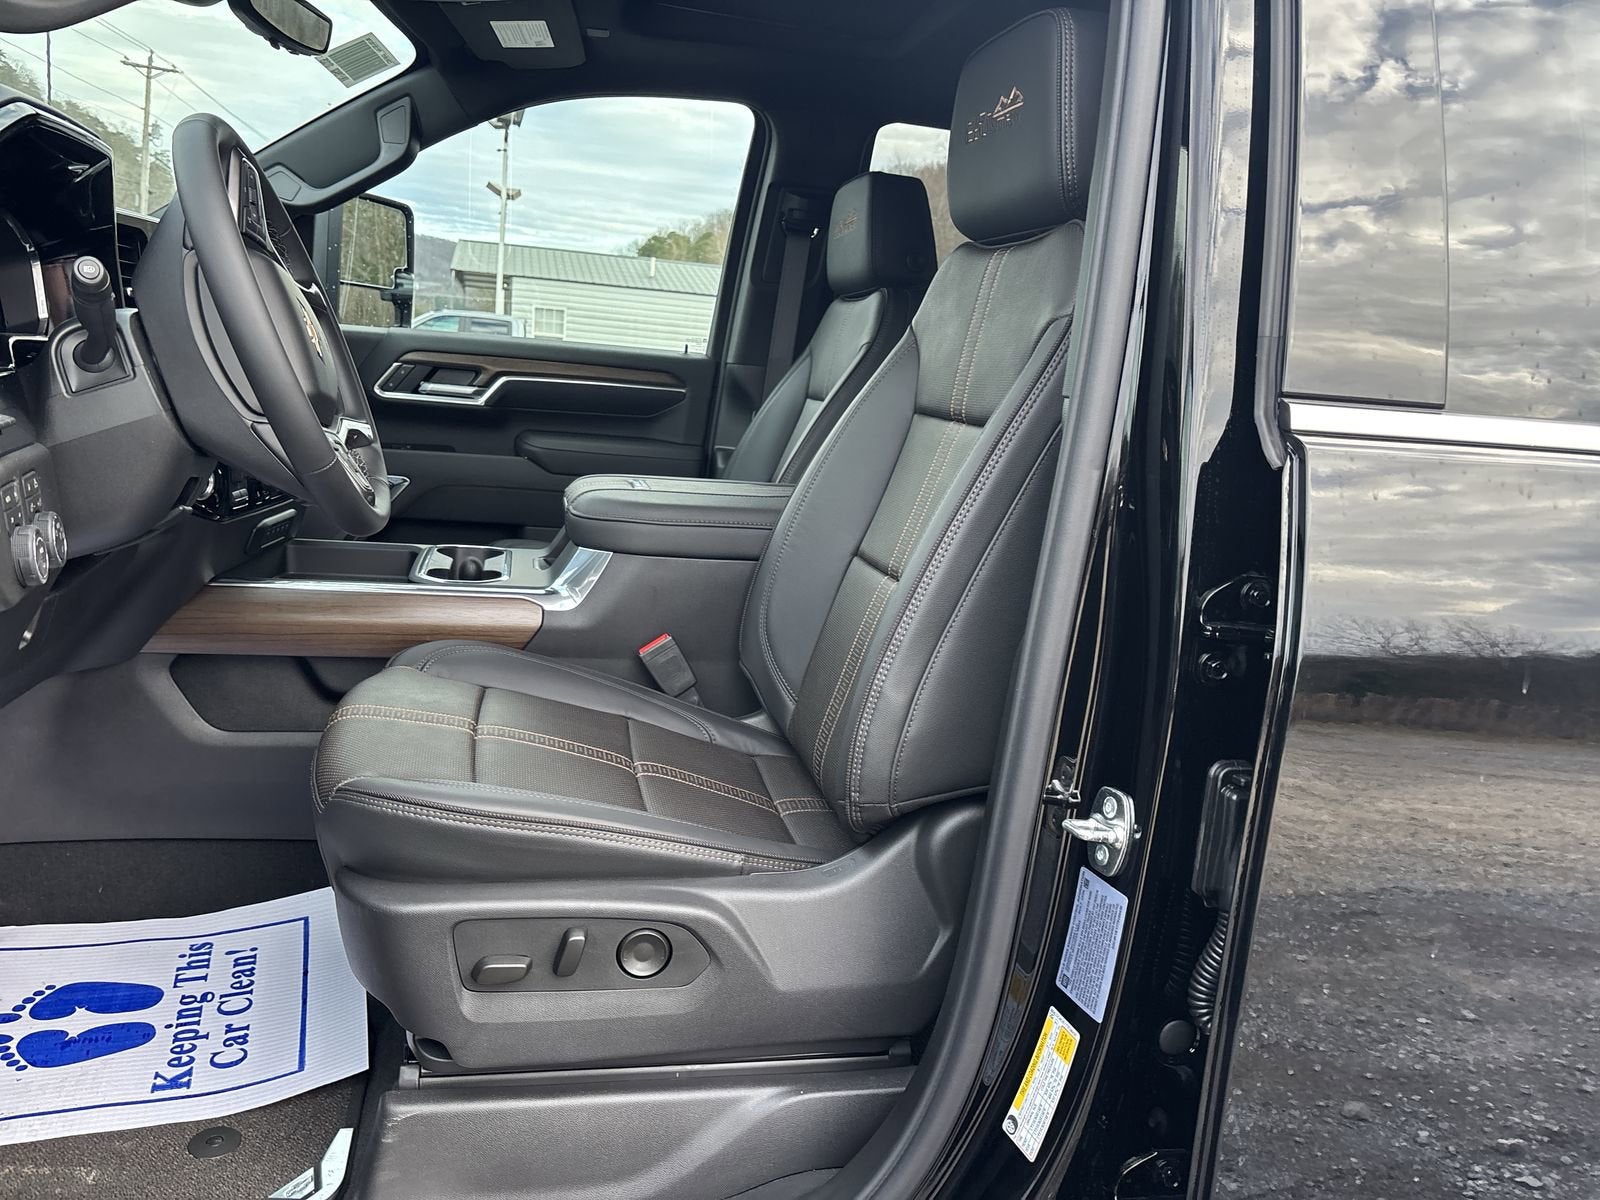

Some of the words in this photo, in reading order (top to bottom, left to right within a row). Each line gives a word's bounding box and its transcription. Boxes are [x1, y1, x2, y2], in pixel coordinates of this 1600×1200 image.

[173, 942, 214, 988] This
[217, 947, 258, 1016] Clean!
[151, 991, 215, 1093] Keeping
[209, 1023, 250, 1069] Car
